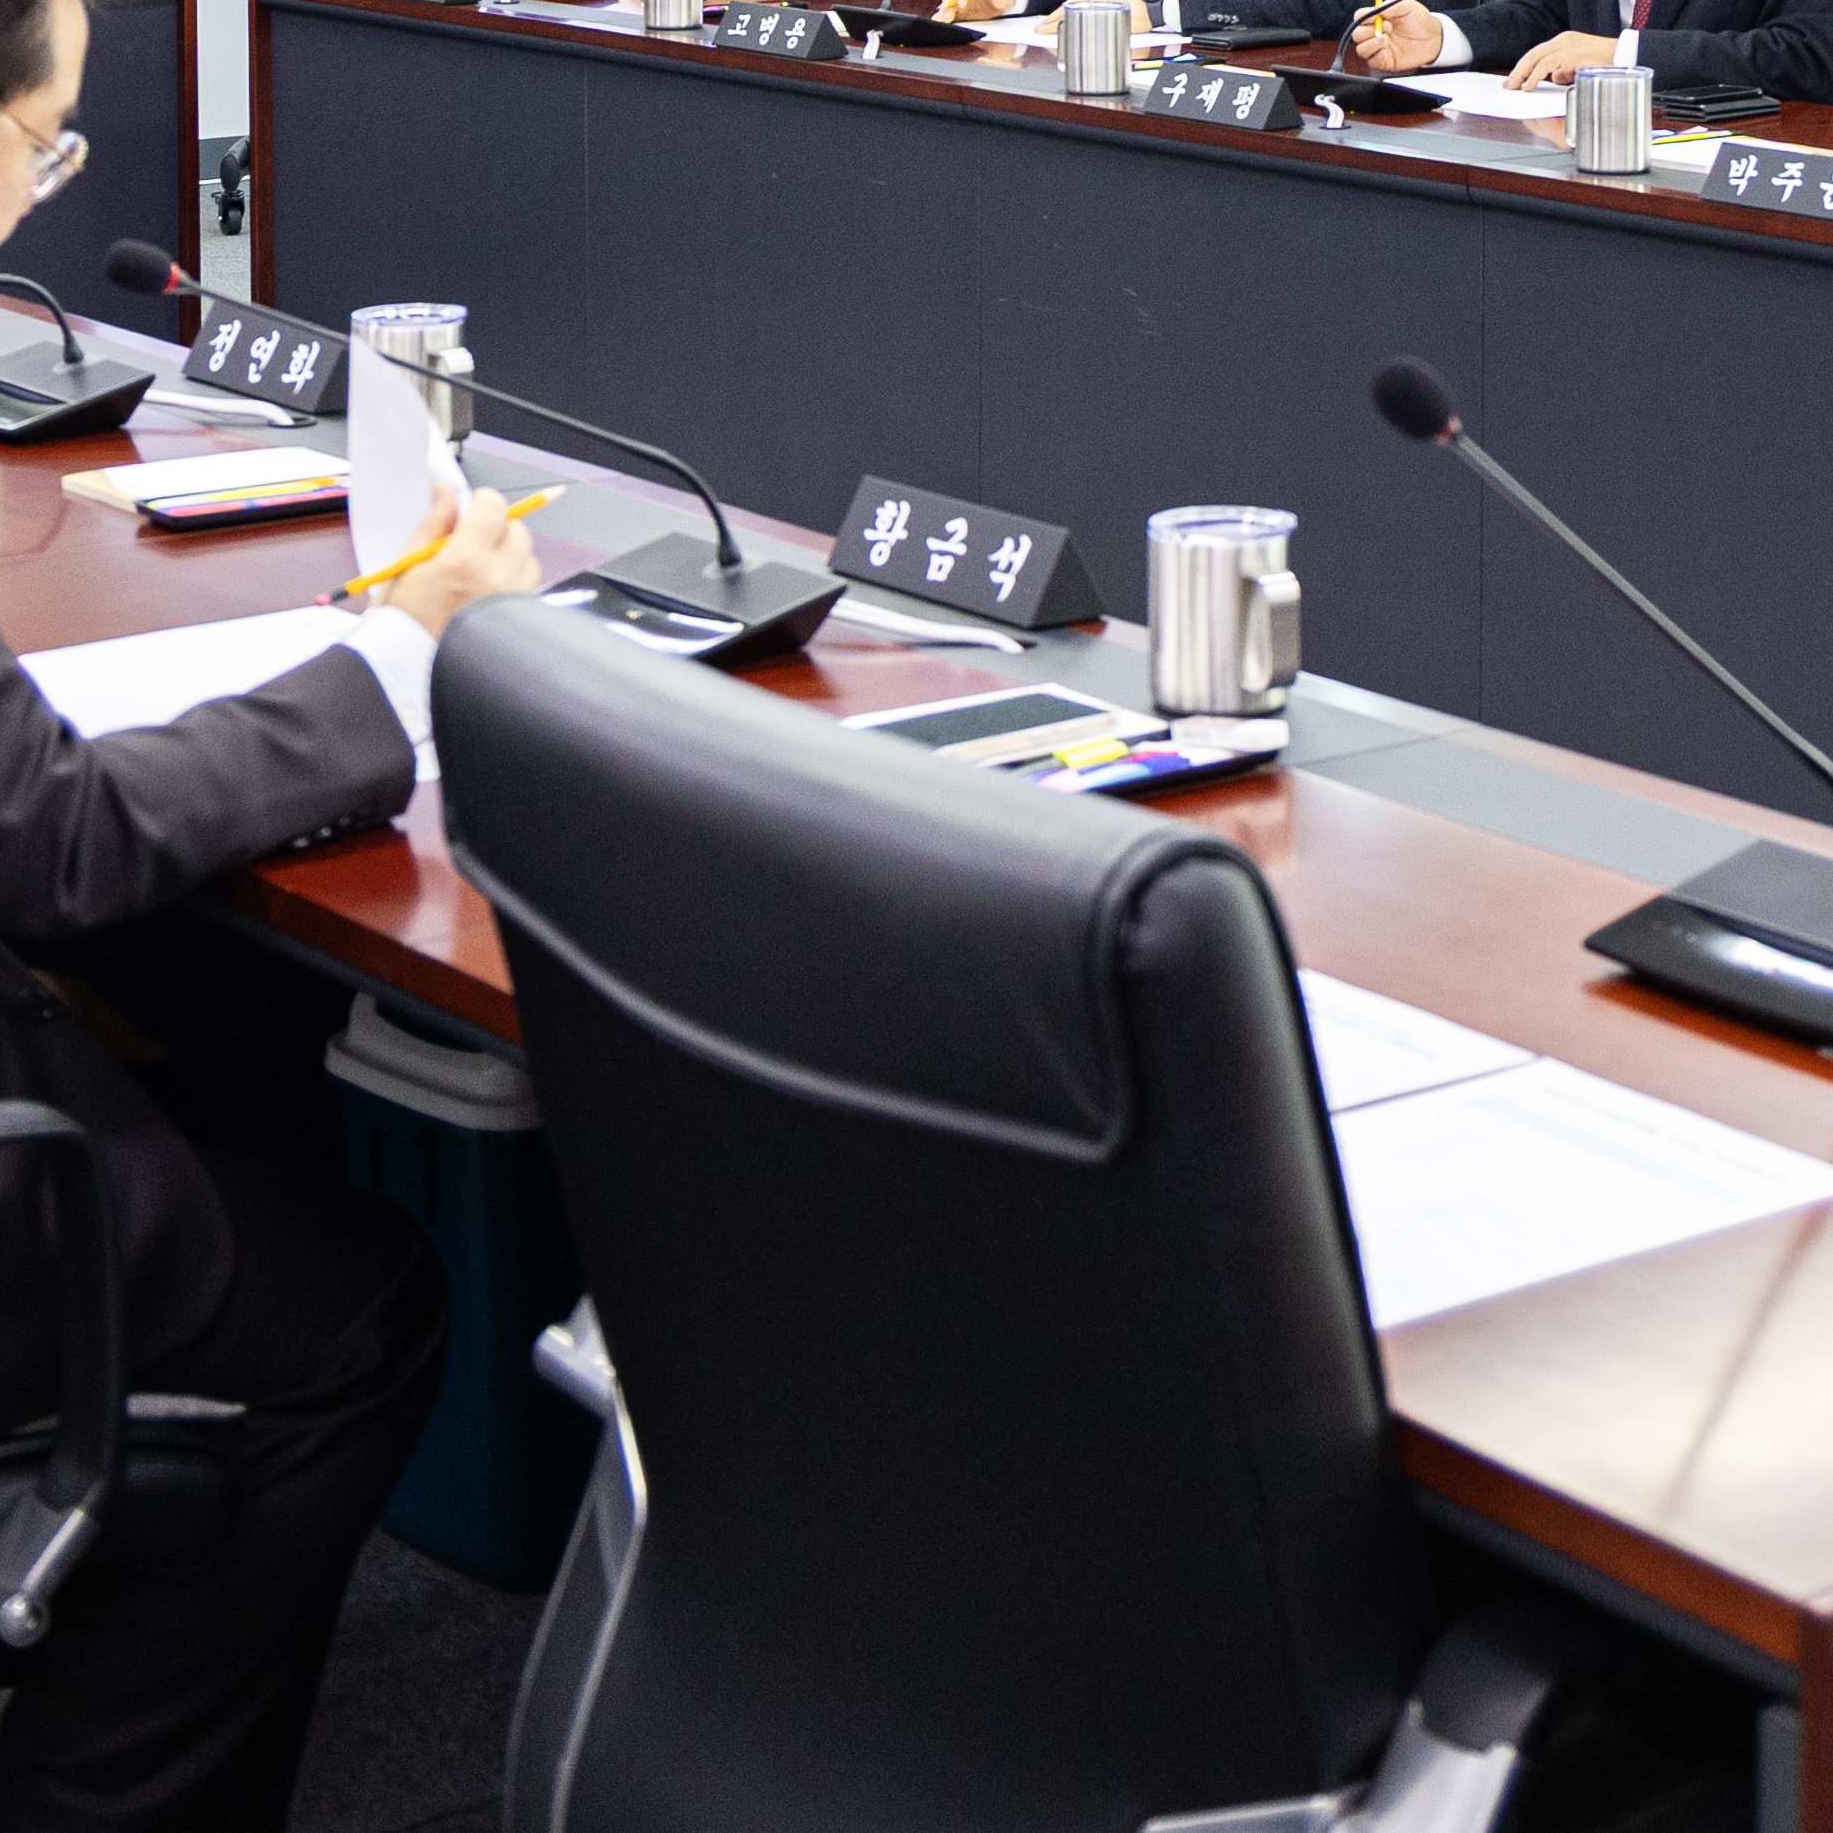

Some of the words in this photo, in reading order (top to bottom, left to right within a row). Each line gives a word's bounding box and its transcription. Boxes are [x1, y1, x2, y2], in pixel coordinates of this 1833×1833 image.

[727, 12, 807, 50] 고병용
[1162, 72, 1261, 120] 구재평
[208, 319, 321, 396] 정연화
[863, 499, 1033, 603] 황금석
